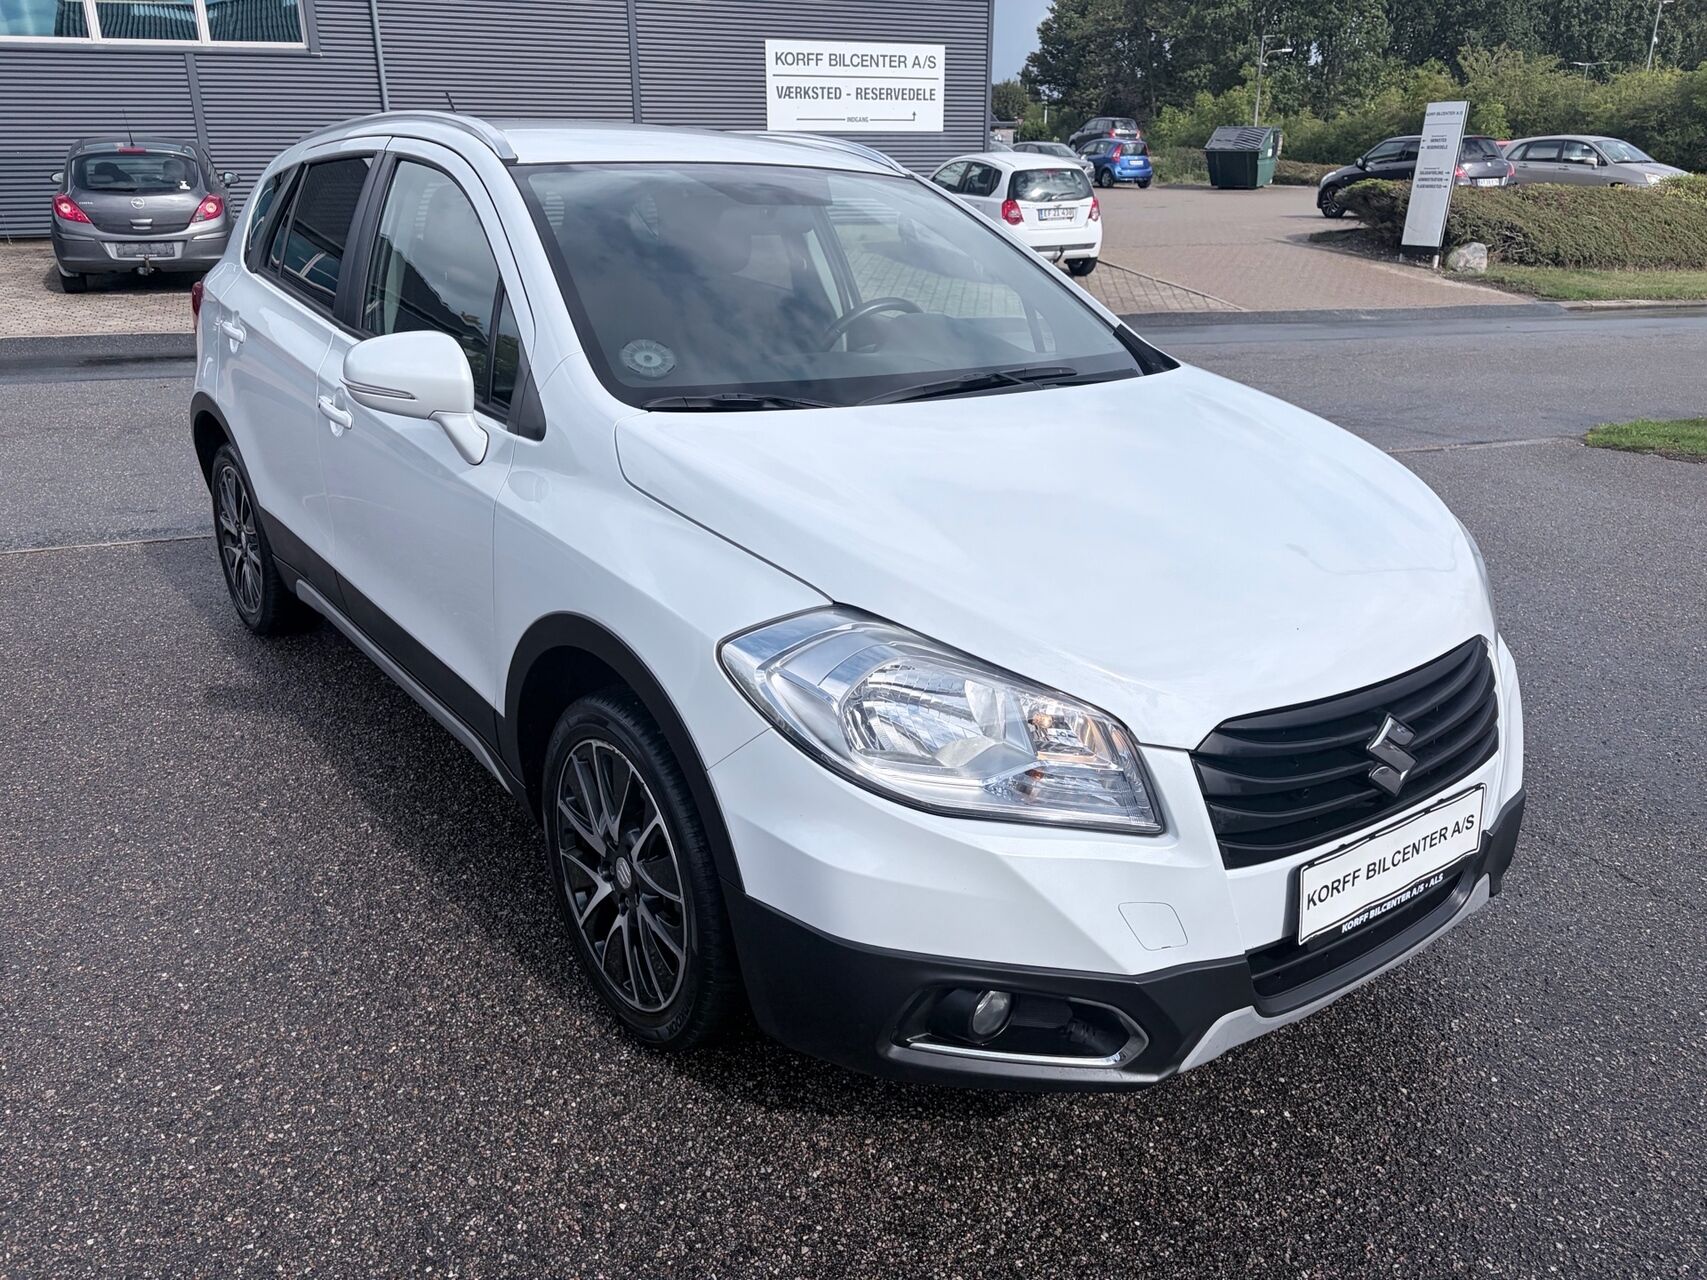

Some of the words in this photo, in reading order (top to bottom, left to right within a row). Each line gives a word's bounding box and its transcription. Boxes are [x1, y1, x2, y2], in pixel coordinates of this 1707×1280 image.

[775, 51, 824, 66] KORFF
[828, 53, 908, 69] BILCENTER
[912, 55, 937, 69] A/S
[776, 85, 842, 100] VÆRKSTED
[855, 87, 936, 101] RESERVEDELE
[1306, 868, 1361, 910] KORFF
[1365, 826, 1448, 880] BILCENTER
[1450, 814, 1475, 838] A/S
[1341, 914, 1369, 933] KORFF
[1368, 891, 1411, 920] BILCENTER
[1410, 885, 1425, 898] A/S
[1429, 873, 1444, 886] ALS
